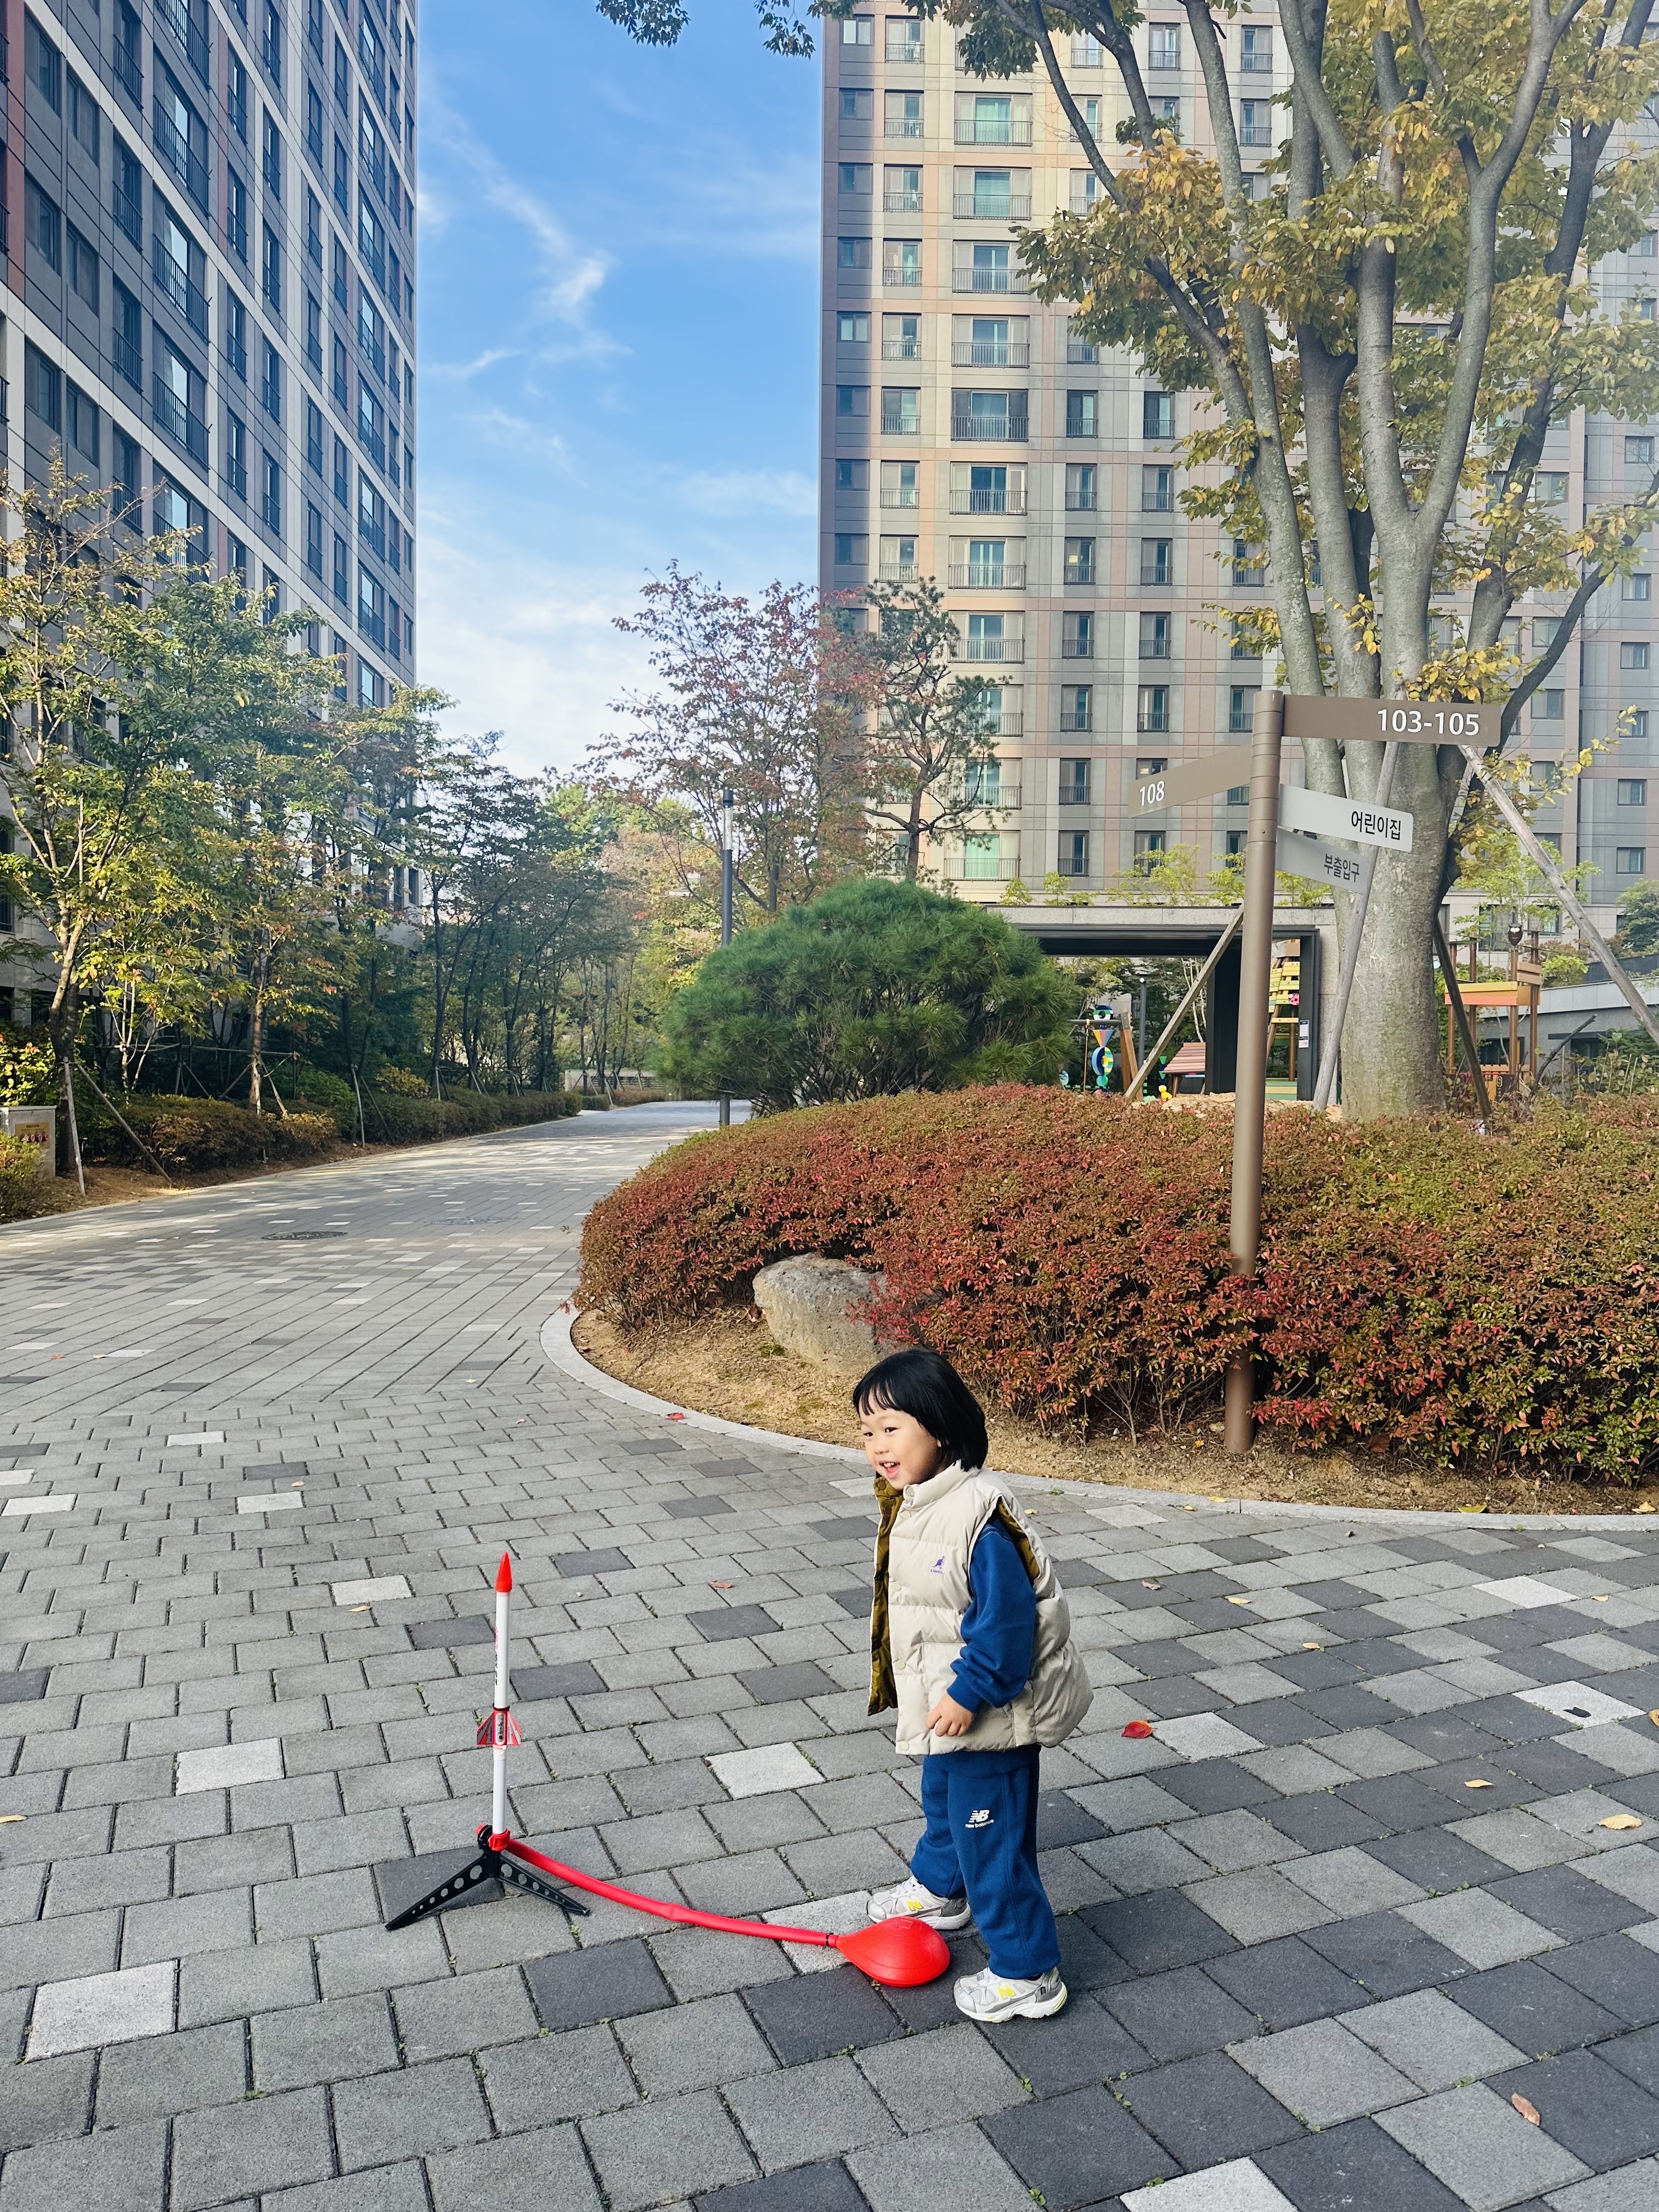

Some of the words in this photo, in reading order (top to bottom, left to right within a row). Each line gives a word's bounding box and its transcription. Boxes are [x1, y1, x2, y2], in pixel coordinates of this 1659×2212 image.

[1378, 708, 1480, 736] 103-105
[1139, 780, 1165, 806] 108
[1351, 811, 1401, 840] 어린이집
[1324, 853, 1359, 883] 부출입구
